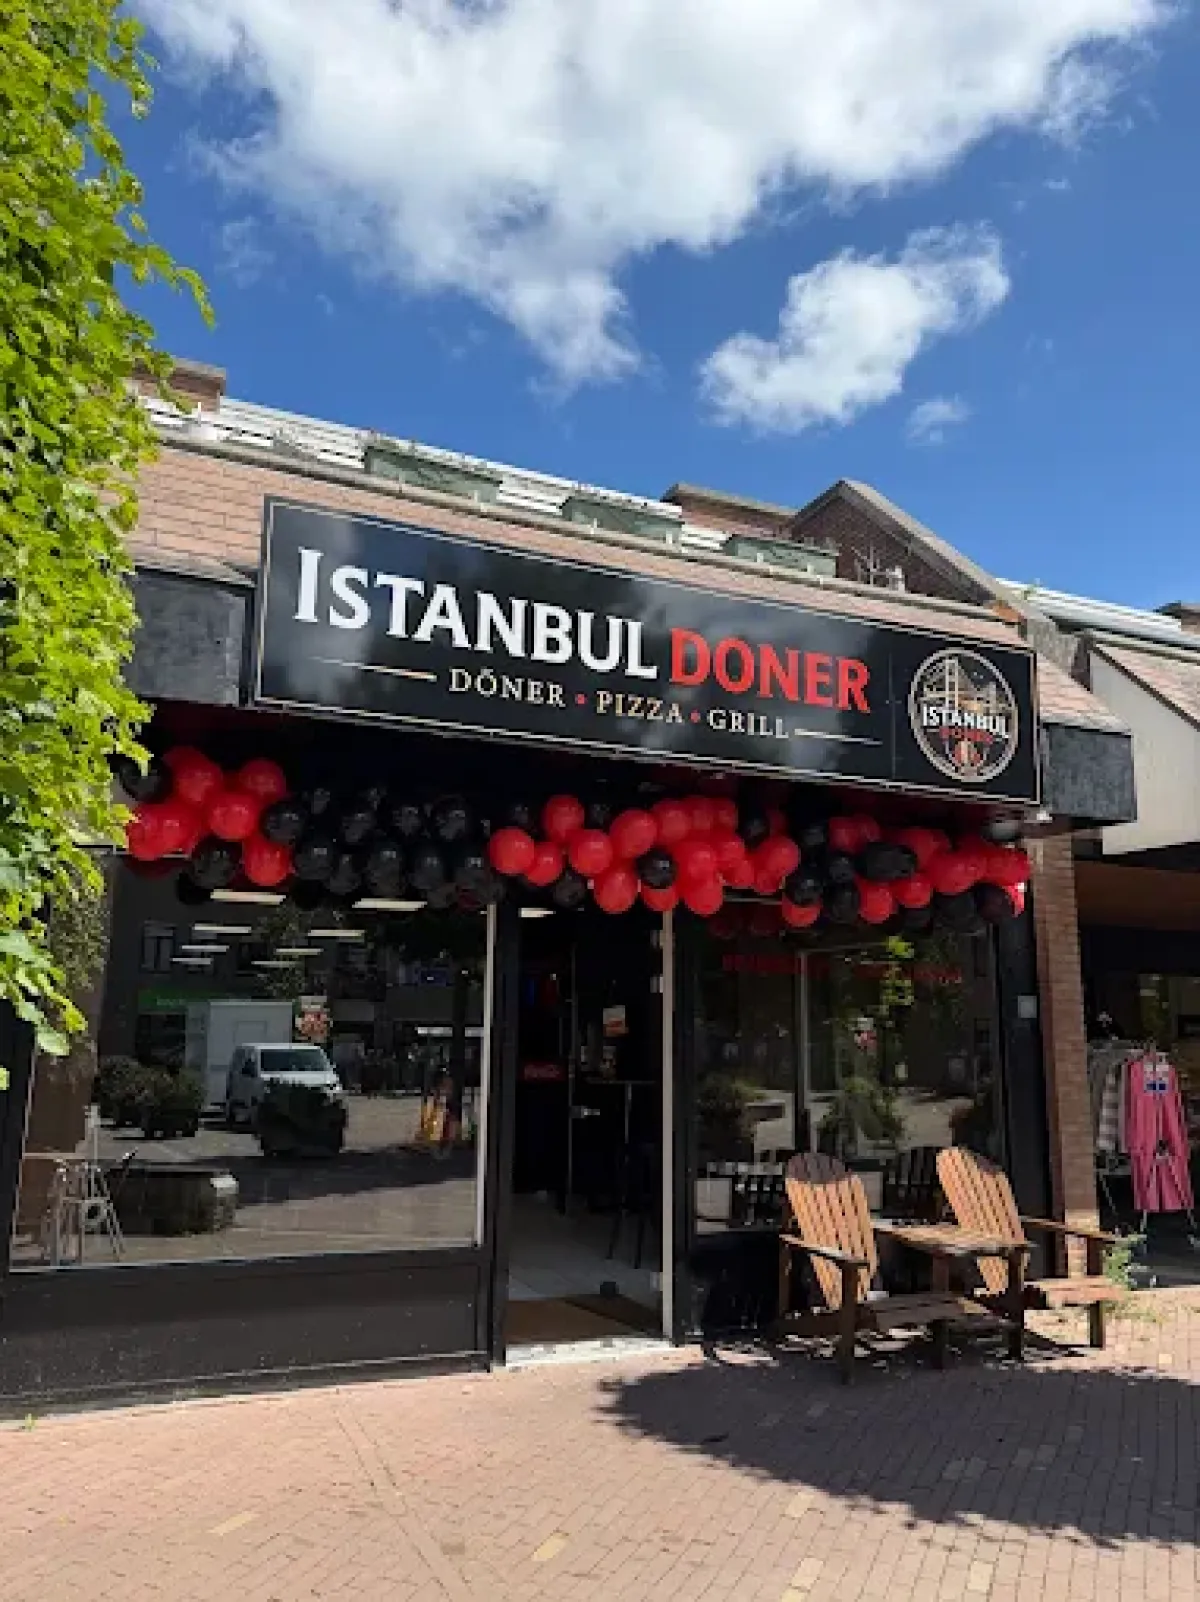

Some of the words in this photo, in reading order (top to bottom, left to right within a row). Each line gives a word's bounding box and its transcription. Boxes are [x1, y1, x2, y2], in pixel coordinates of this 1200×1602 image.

[292, 546, 658, 680] ISTANBUL
[669, 627, 871, 714] DONER
[448, 667, 566, 709] DÖNER
[596, 689, 684, 725] PIZZA
[708, 708, 790, 739] GRILL
